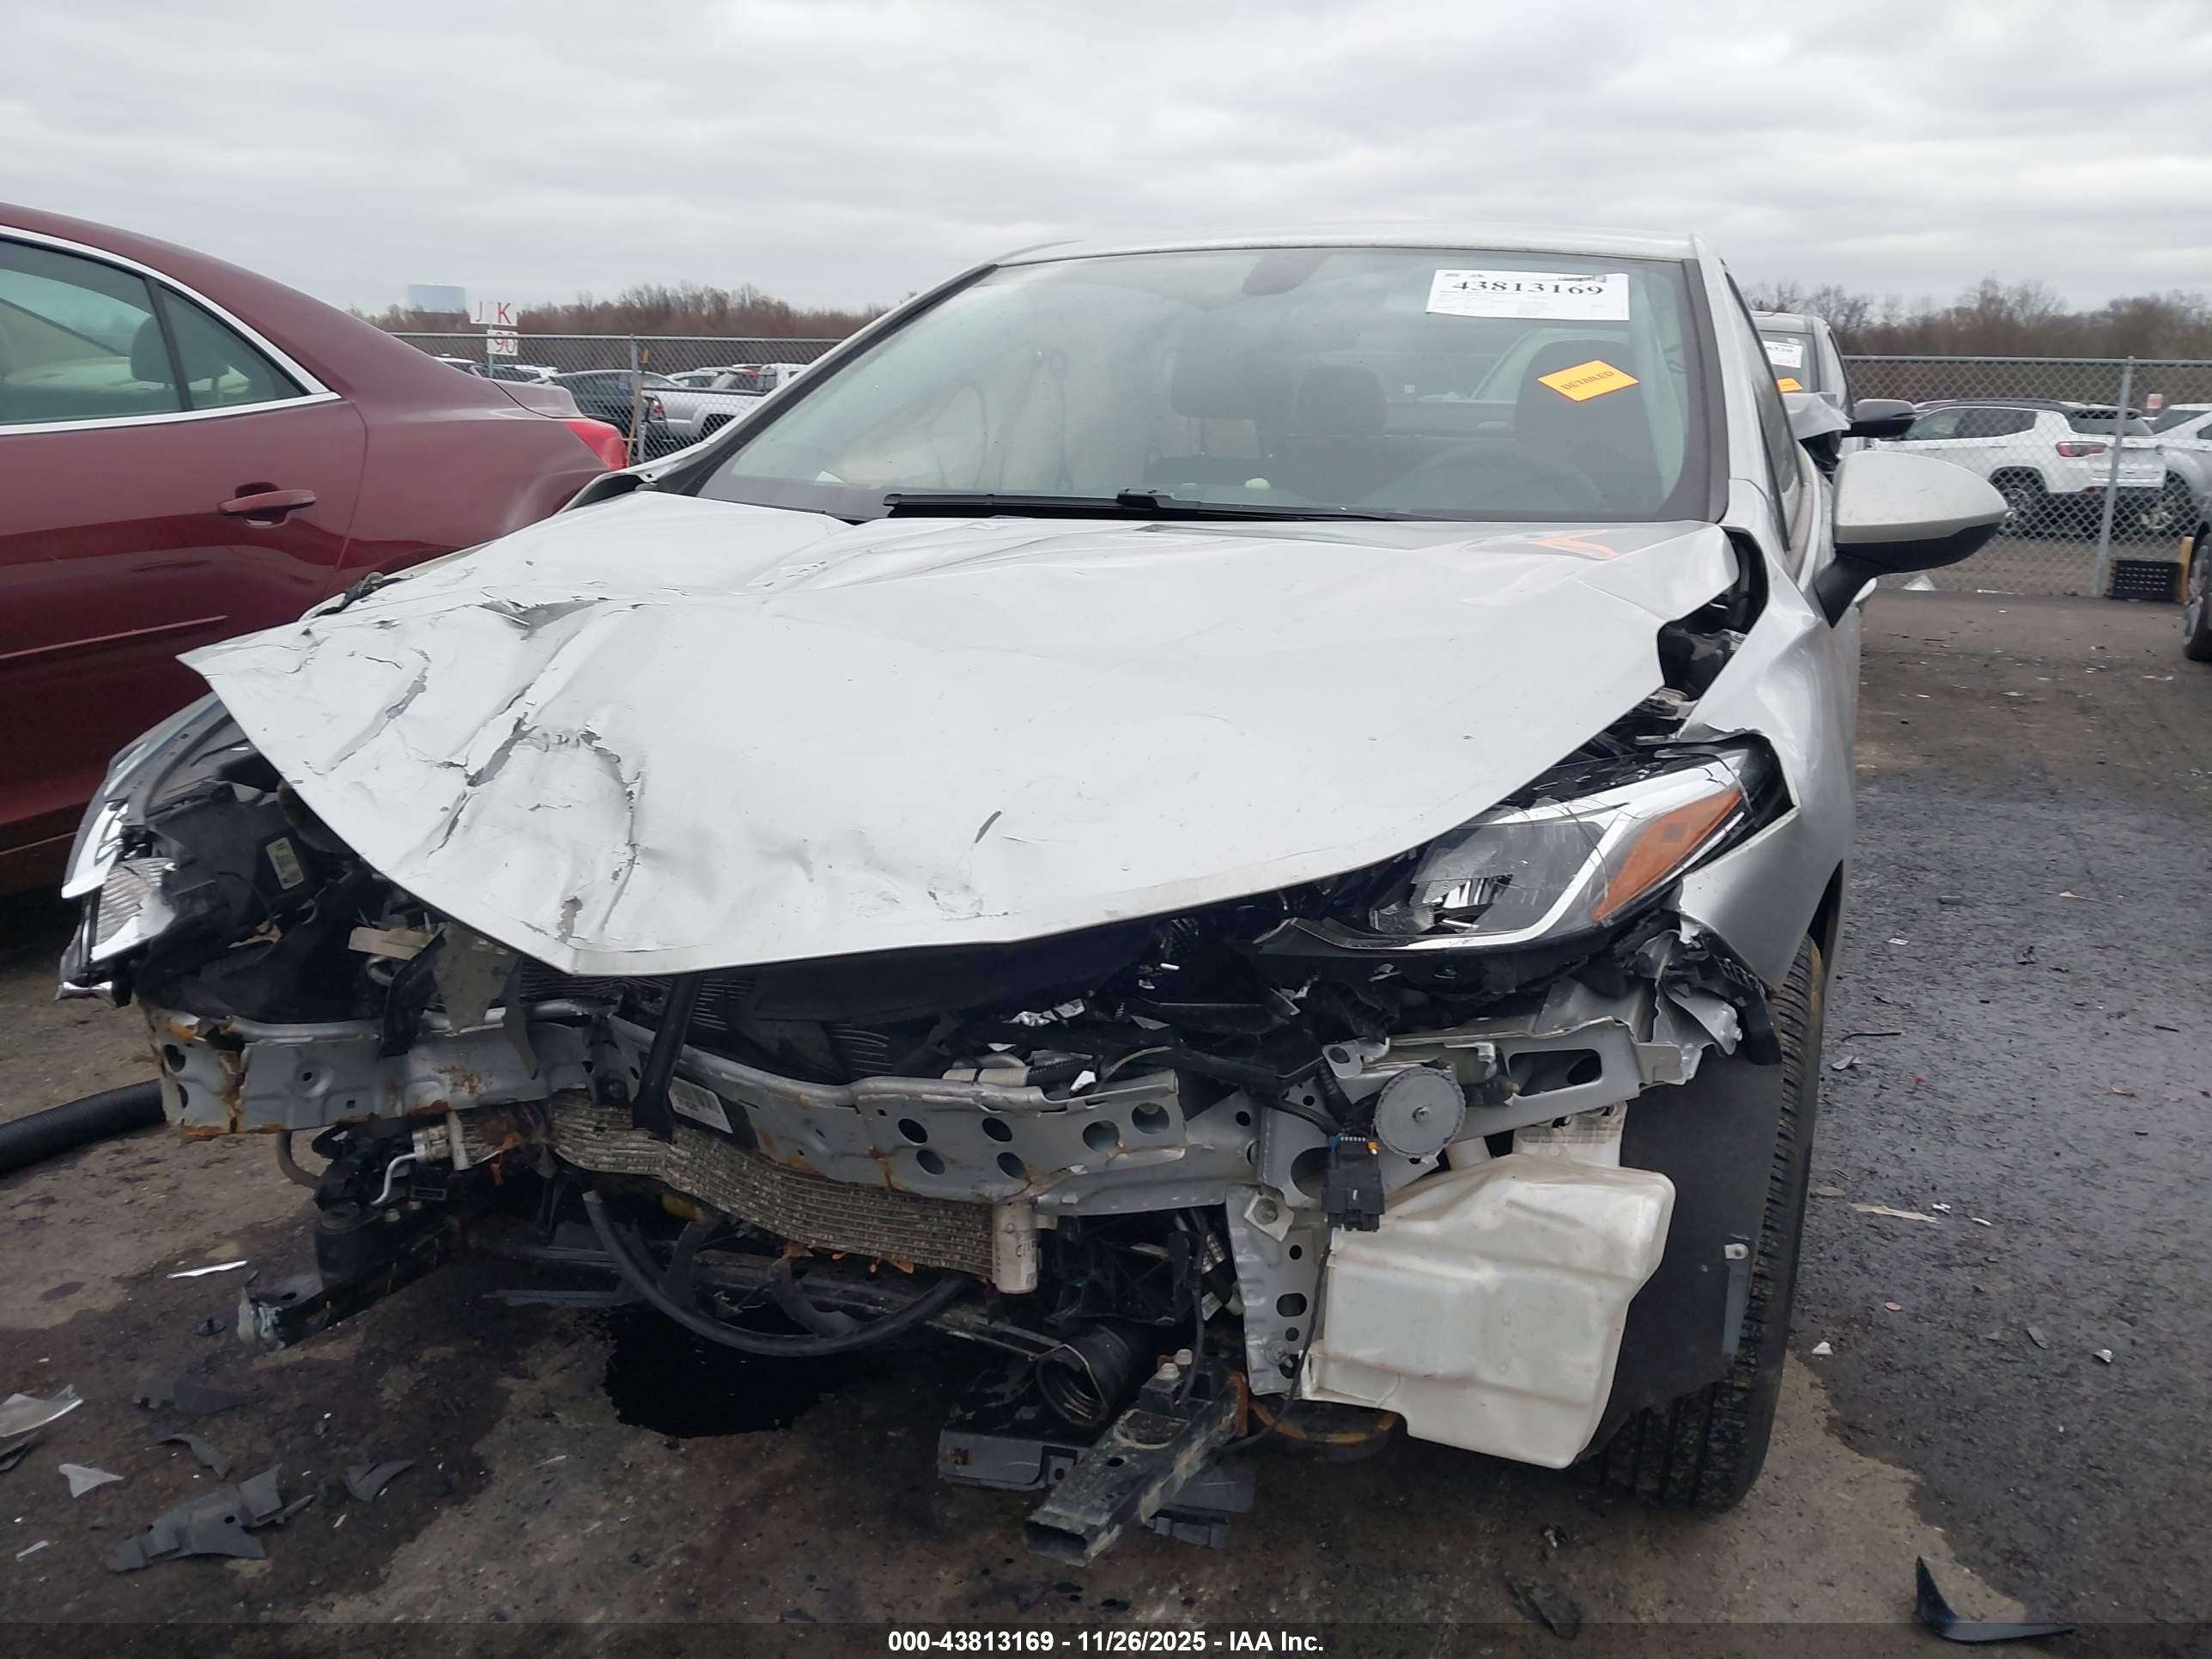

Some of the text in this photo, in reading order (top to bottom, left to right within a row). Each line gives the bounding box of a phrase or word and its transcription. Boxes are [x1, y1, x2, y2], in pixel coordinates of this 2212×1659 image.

[1452, 281, 1603, 295] 43813169
[498, 302, 512, 324] K
[1561, 371, 1614, 390] DETAILED
